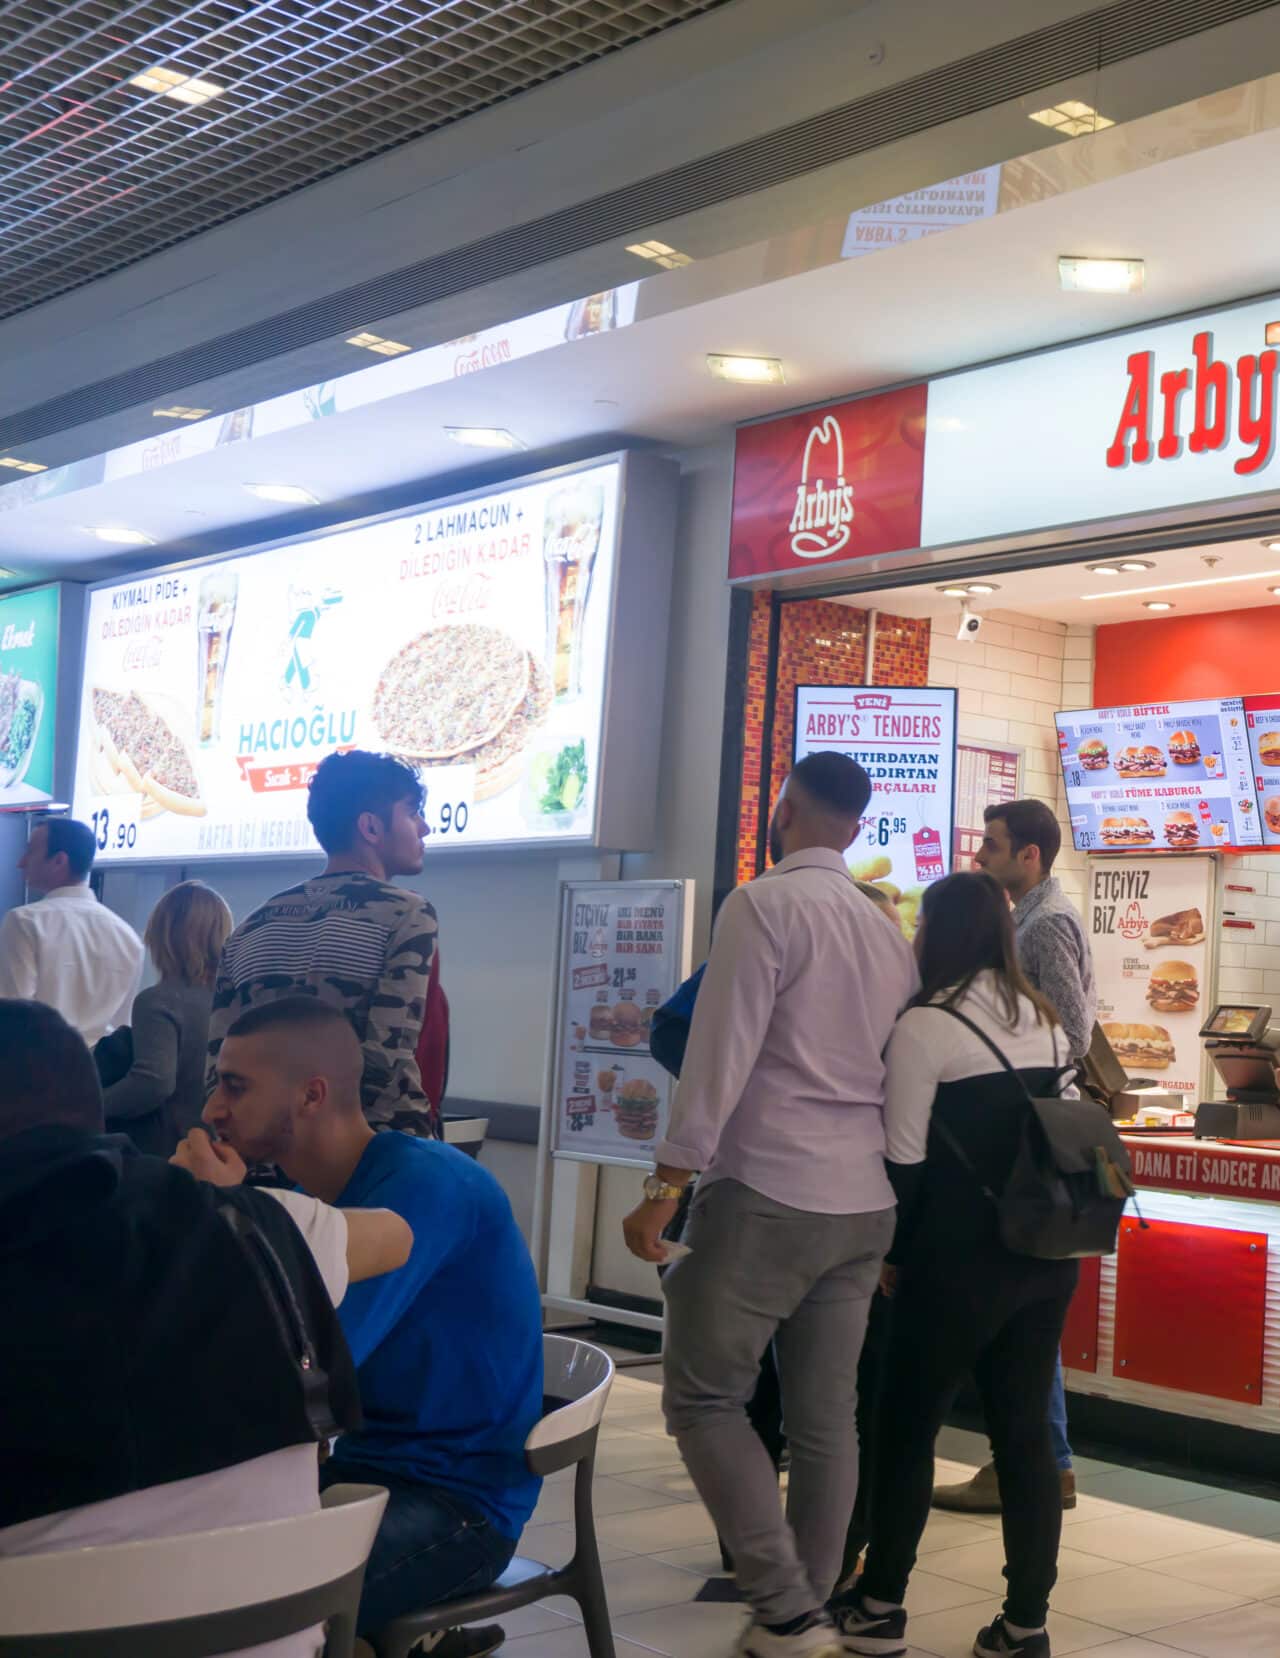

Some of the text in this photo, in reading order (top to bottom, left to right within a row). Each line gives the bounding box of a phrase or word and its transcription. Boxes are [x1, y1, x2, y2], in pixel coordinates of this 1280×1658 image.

[426, 501, 512, 541] LAHMACUN
[789, 477, 855, 537] Arby's
[477, 533, 531, 565] KADAR
[806, 714, 942, 738] ARBY'S TENDERS
[1133, 705, 1170, 717] BİFTEK
[239, 707, 358, 754] HACIOĞLU
[866, 767, 938, 780] LDIRTAN
[872, 782, 937, 795] RÇALARI
[1125, 787, 1153, 798] FÜME
[1154, 785, 1203, 797] KABURGA
[1094, 870, 1150, 902] ETÇİYİZ
[1093, 904, 1116, 934] BİZ
[1135, 1153, 1171, 1179] DANA
[1176, 1151, 1197, 1182] ETİ
[1202, 1158, 1256, 1188] SADECE
